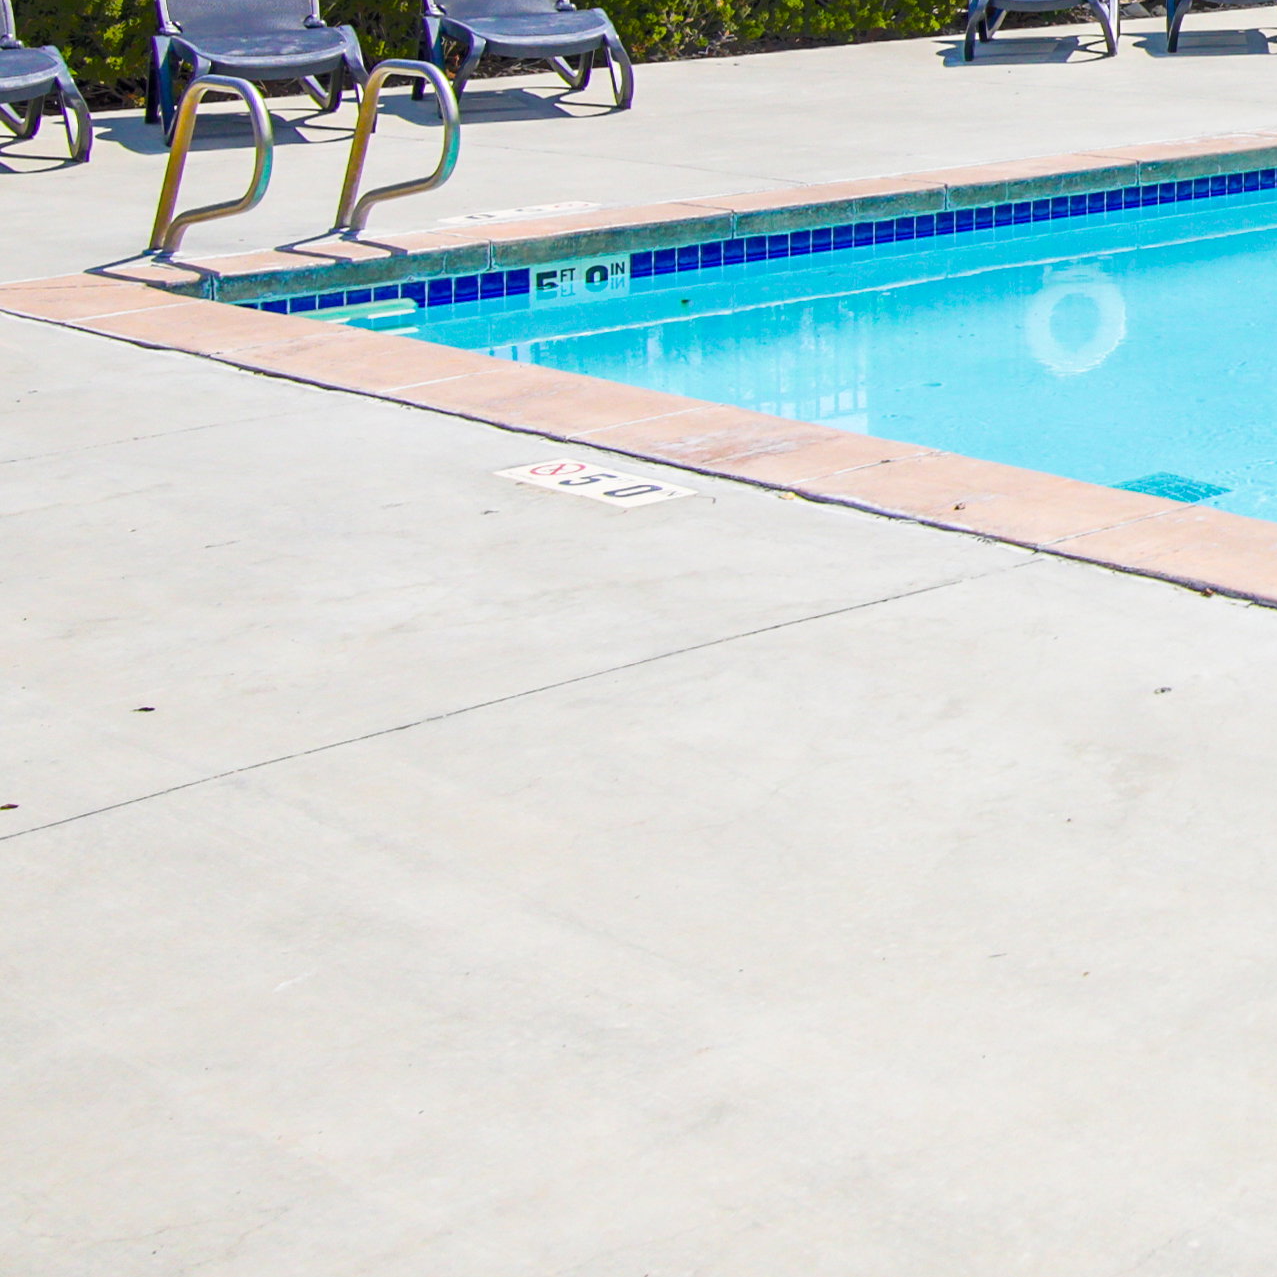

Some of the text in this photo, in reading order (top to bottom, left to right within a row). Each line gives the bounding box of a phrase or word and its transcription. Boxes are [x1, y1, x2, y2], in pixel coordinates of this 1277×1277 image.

[536, 261, 625, 291] 5 FT 0 IN
